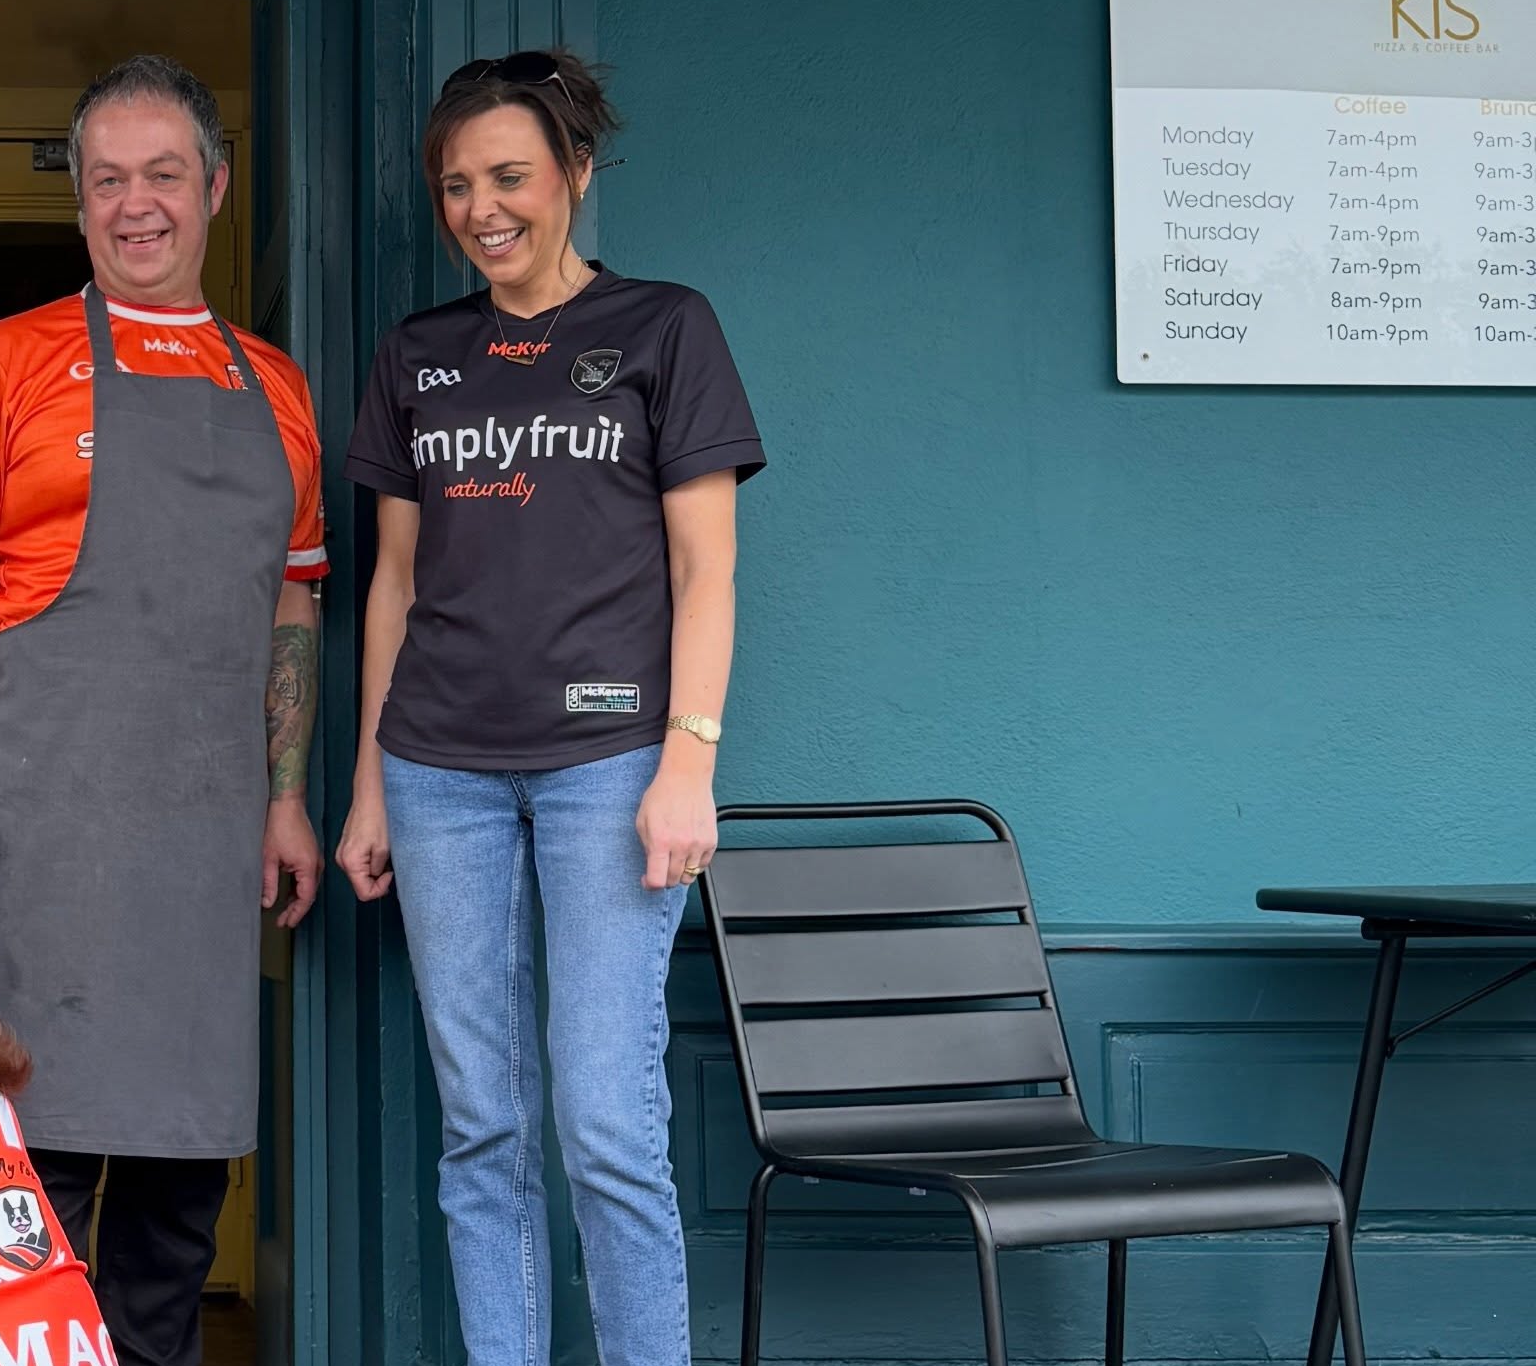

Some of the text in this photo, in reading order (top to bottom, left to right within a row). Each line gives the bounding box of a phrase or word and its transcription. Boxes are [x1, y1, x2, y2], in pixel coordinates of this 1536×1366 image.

[1373, 43, 1406, 52] PIZZA
[1426, 43, 1470, 53] COFFEE
[1476, 44, 1500, 53] BAR
[1334, 96, 1407, 115] Coffee
[1163, 126, 1536, 151] Monday 7am-4pm 9am-3
[1162, 158, 1536, 183] Tuesday 7am-4pm 9am-3
[1163, 190, 1294, 214] Wednesday
[1328, 193, 1419, 215] 7am-4pm
[1164, 222, 1260, 246] Thursday
[1329, 225, 1420, 247] 7am-9pm
[1163, 254, 1228, 277] Friday
[1330, 258, 1421, 280] 7am-9pm
[1165, 288, 1263, 311] Saturday
[1331, 291, 1422, 313] 8am-9pm
[1165, 321, 1536, 346] Sunday 10am-9pm 10am-
[411, 414, 624, 472] implyfruit
[444, 472, 535, 507] naturally
